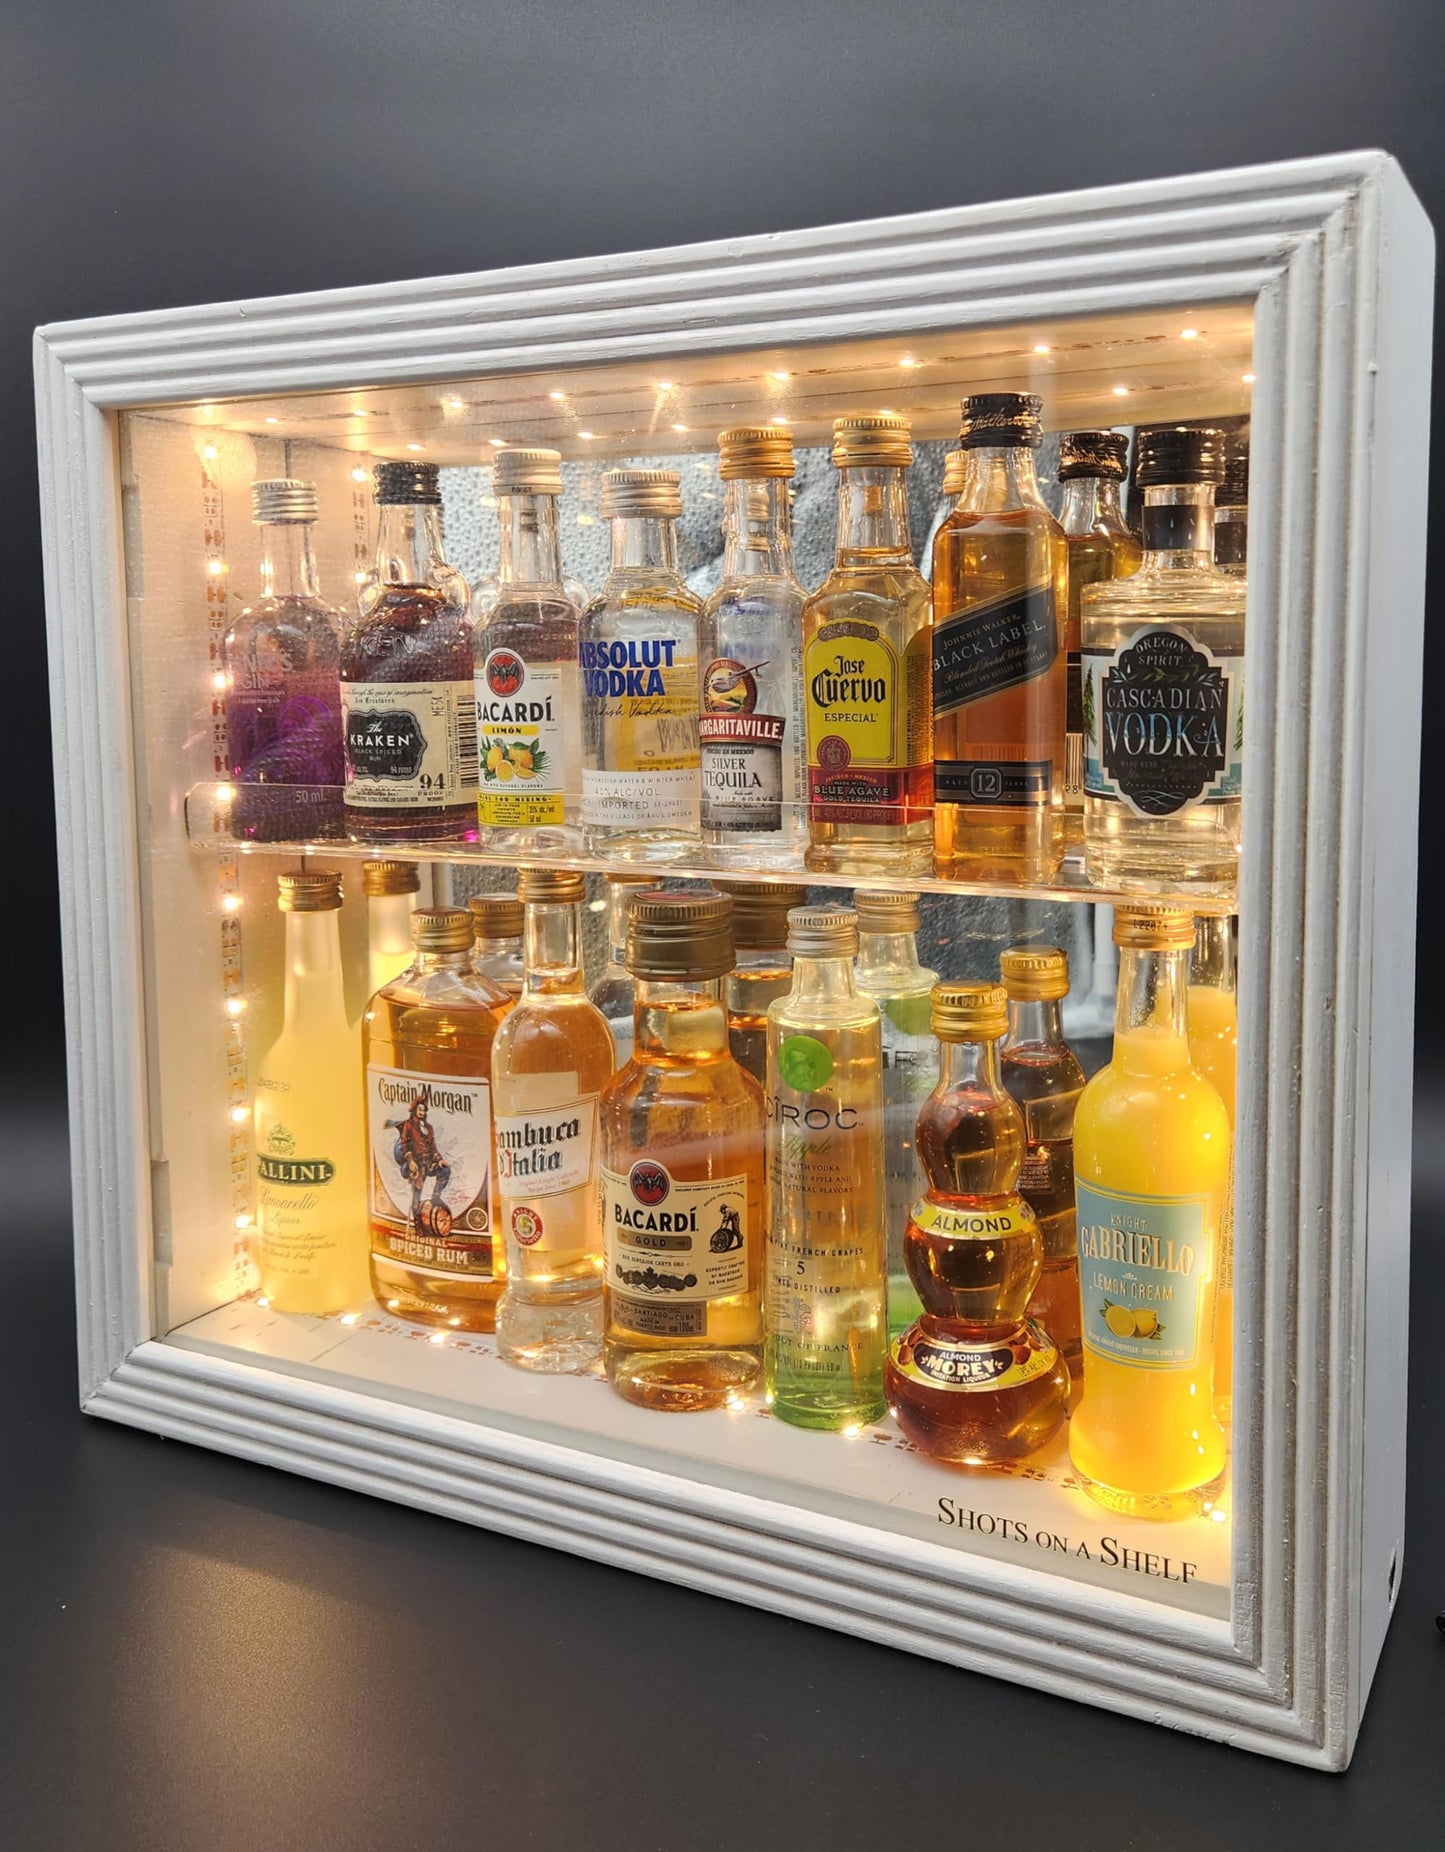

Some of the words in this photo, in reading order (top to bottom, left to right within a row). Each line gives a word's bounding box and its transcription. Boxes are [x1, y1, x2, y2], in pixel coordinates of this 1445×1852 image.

[943, 629, 981, 650] JOHNNIE
[982, 614, 1018, 632] WALKER
[933, 642, 984, 671] BLACK
[989, 619, 1043, 649] LABEL
[1136, 636, 1189, 654] OREGON
[579, 640, 677, 669] ABSOLUT
[945, 662, 980, 684] Blended
[1006, 643, 1038, 659] Whisky
[1138, 655, 1182, 666] SPIRIT
[834, 655, 865, 678] Jose
[240, 673, 269, 689] GIN
[582, 669, 666, 697] VODKA
[811, 668, 886, 709] Cuervo
[1106, 687, 1223, 710] CASCADIAN
[477, 696, 552, 723] BACARDÍ
[629, 700, 673, 718] Vodka
[824, 712, 877, 723] ESPECIAL
[366, 720, 382, 733] The
[492, 725, 522, 735] LIMÓN
[700, 718, 783, 740] ARGARITAVILLE
[1105, 712, 1224, 758] VODKA
[350, 735, 410, 747] KRAKEN
[712, 758, 746, 770] SILVER
[420, 773, 445, 789] 94
[675, 774, 696, 782] WHEAT
[704, 770, 762, 791] TEQUILA
[977, 773, 996, 793] 12
[295, 790, 309, 803] 50
[614, 787, 660, 797] ALC/VOL
[814, 785, 844, 794] BLUE
[848, 786, 890, 797] AGAVE
[598, 800, 649, 810] IMPORTED
[378, 1077, 418, 1107] Captain
[418, 1083, 473, 1117] Morgan
[499, 1117, 580, 1149] ambuca
[258, 1159, 325, 1181] ALLINI
[812, 1164, 840, 1172] VODKA
[614, 1203, 697, 1233] BACARDÍ
[930, 1214, 1012, 1233] ALMOND
[1110, 1213, 1149, 1232] KNIGHT
[404, 1232, 448, 1248] ORIGINAL
[635, 1235, 666, 1247] GOLD
[389, 1236, 433, 1260] SPICED
[436, 1247, 469, 1265] RUM
[792, 1245, 826, 1256] FRENCH
[831, 1247, 864, 1257] GRAPES
[1081, 1226, 1195, 1278] GABRIELLO
[796, 1261, 806, 1275] 5
[794, 1282, 841, 1293] DISTILLED
[1093, 1271, 1127, 1296] LEMON
[1130, 1284, 1175, 1301] CREAM
[634, 1308, 668, 1319] SANTIAGO
[675, 1313, 694, 1321] CUBA
[817, 1342, 863, 1352] FRANE
[939, 1351, 982, 1362] ALMOND
[926, 1356, 995, 1376] MOREY
[963, 1372, 991, 1383] LIQUEUR
[938, 1497, 1029, 1544] SHOTS
[1035, 1530, 1069, 1554] ON
[1076, 1542, 1092, 1560] A
[1100, 1536, 1198, 1584] SHELF
